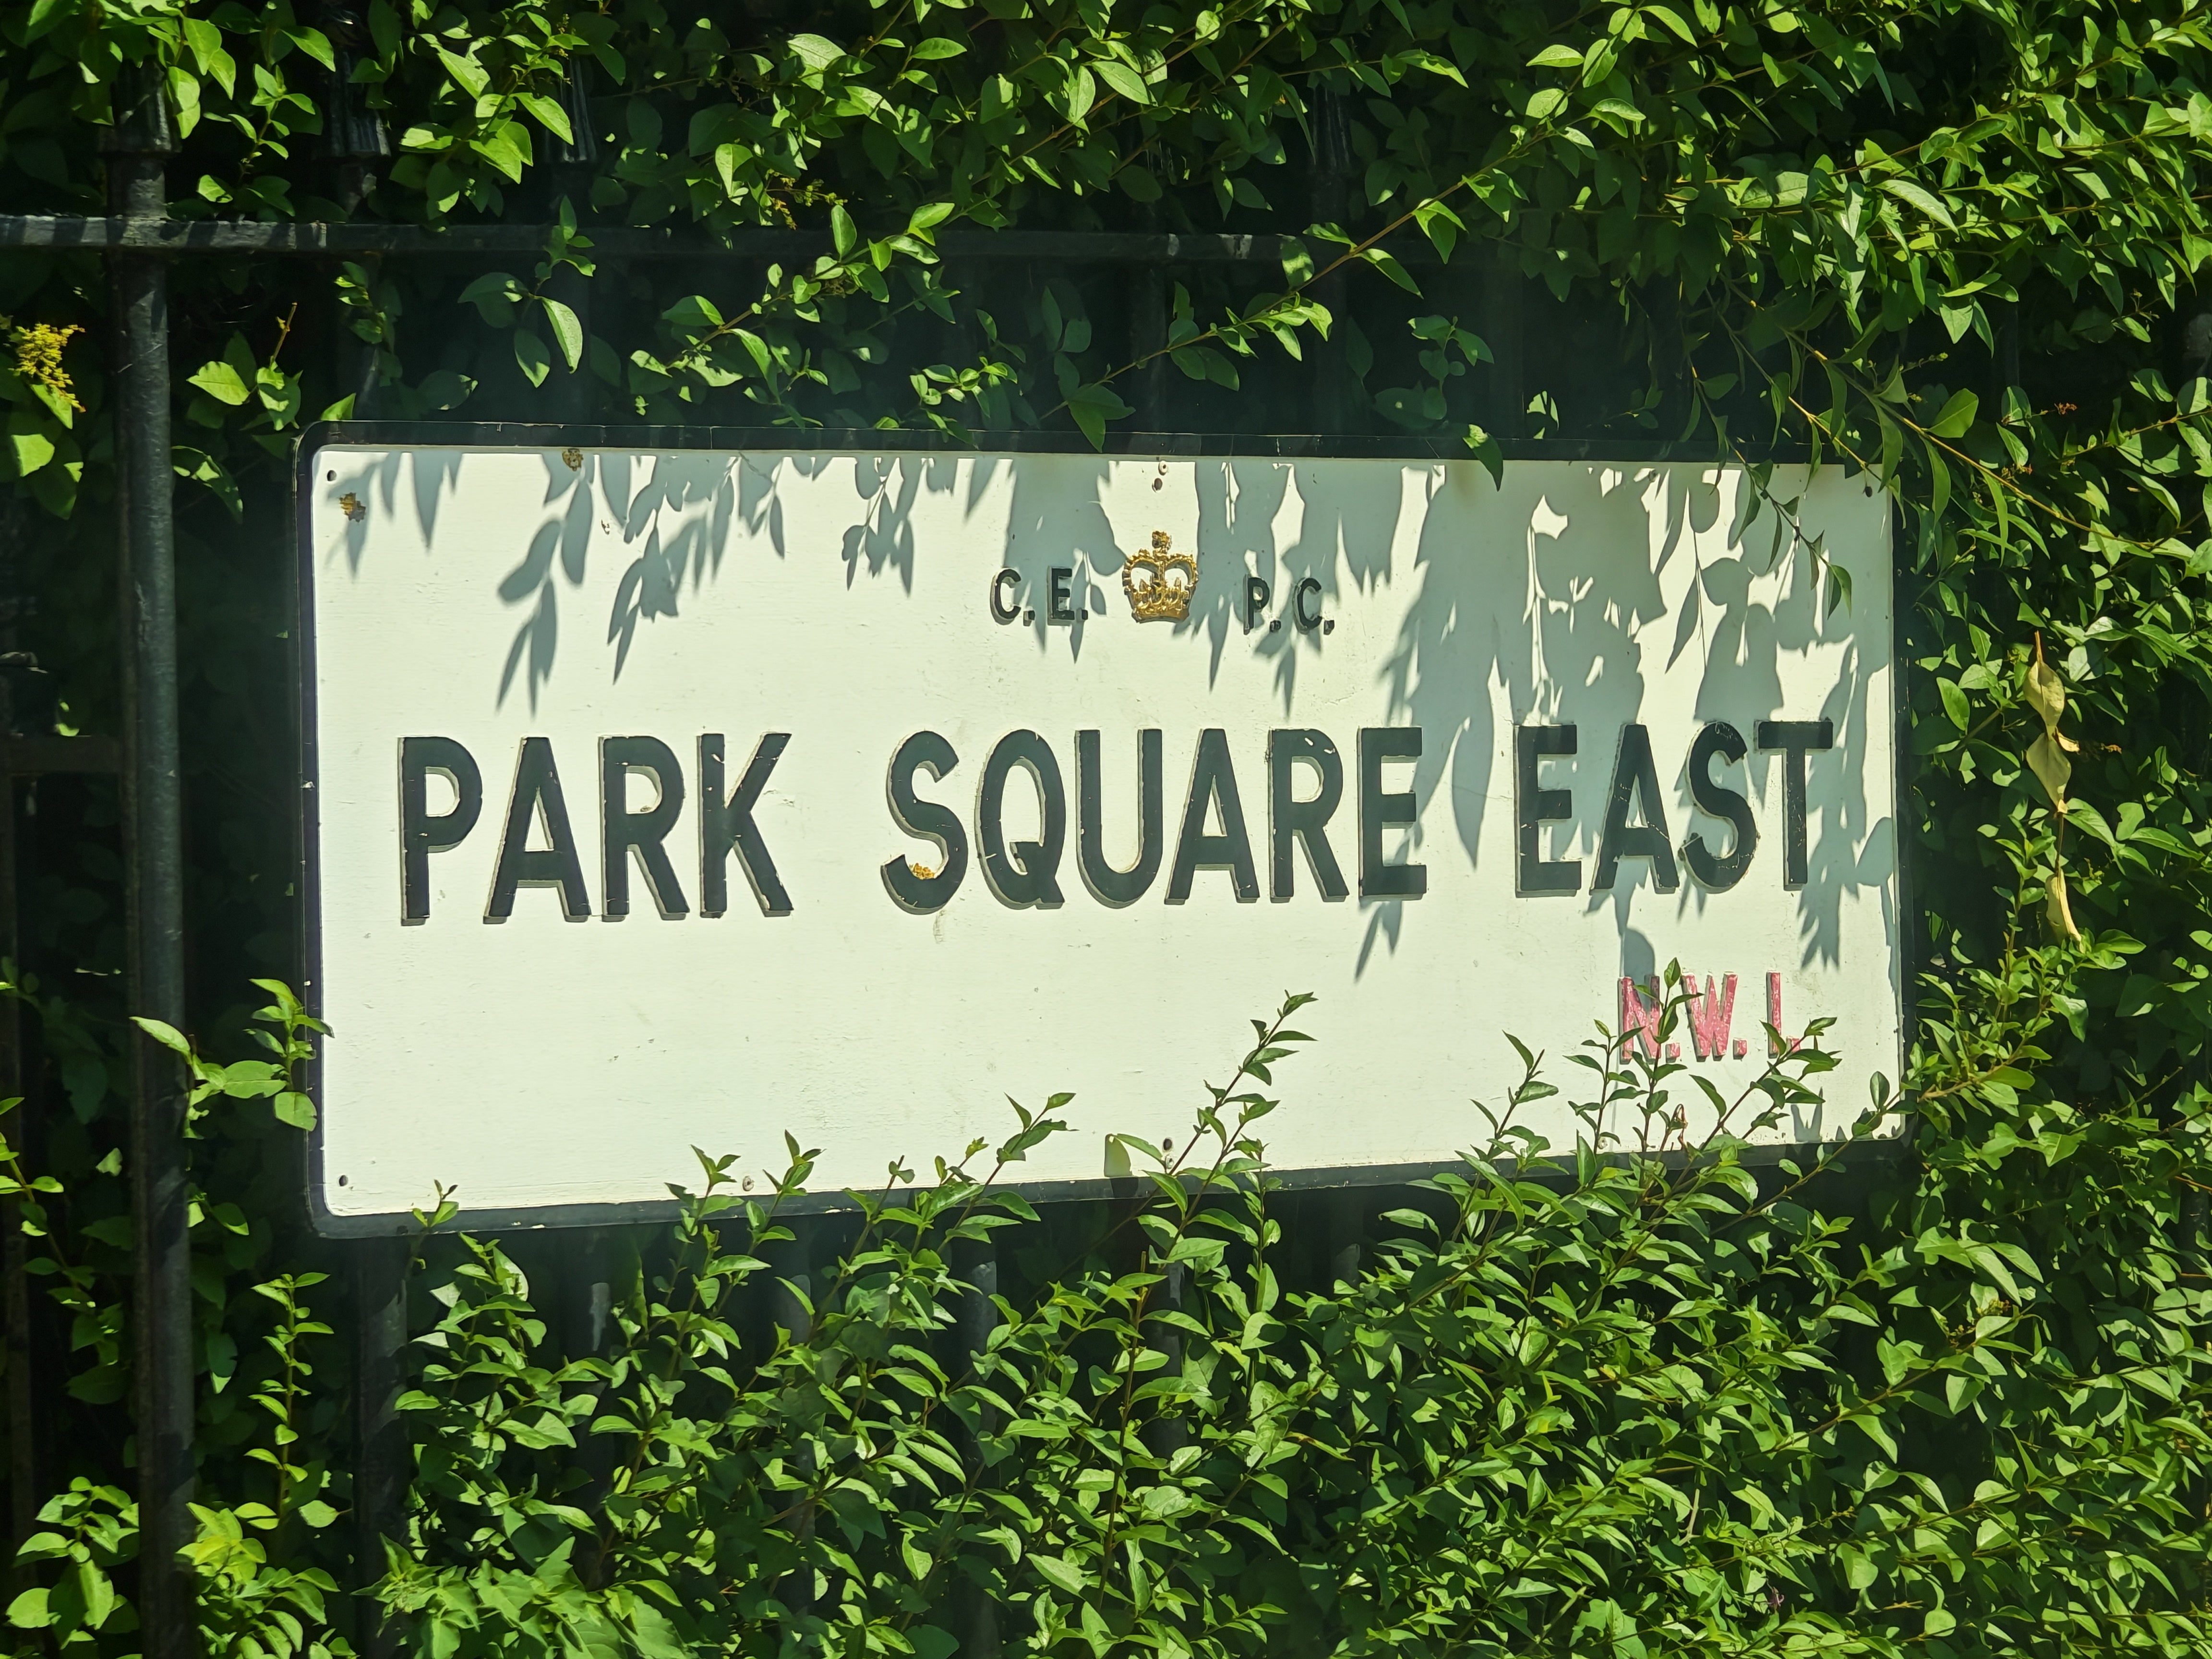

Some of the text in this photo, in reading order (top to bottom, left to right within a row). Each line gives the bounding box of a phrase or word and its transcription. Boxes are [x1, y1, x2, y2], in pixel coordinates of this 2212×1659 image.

[990, 566, 1335, 636] C.E. P.C.
[397, 721, 1834, 926] PARK SQUARE EAST
